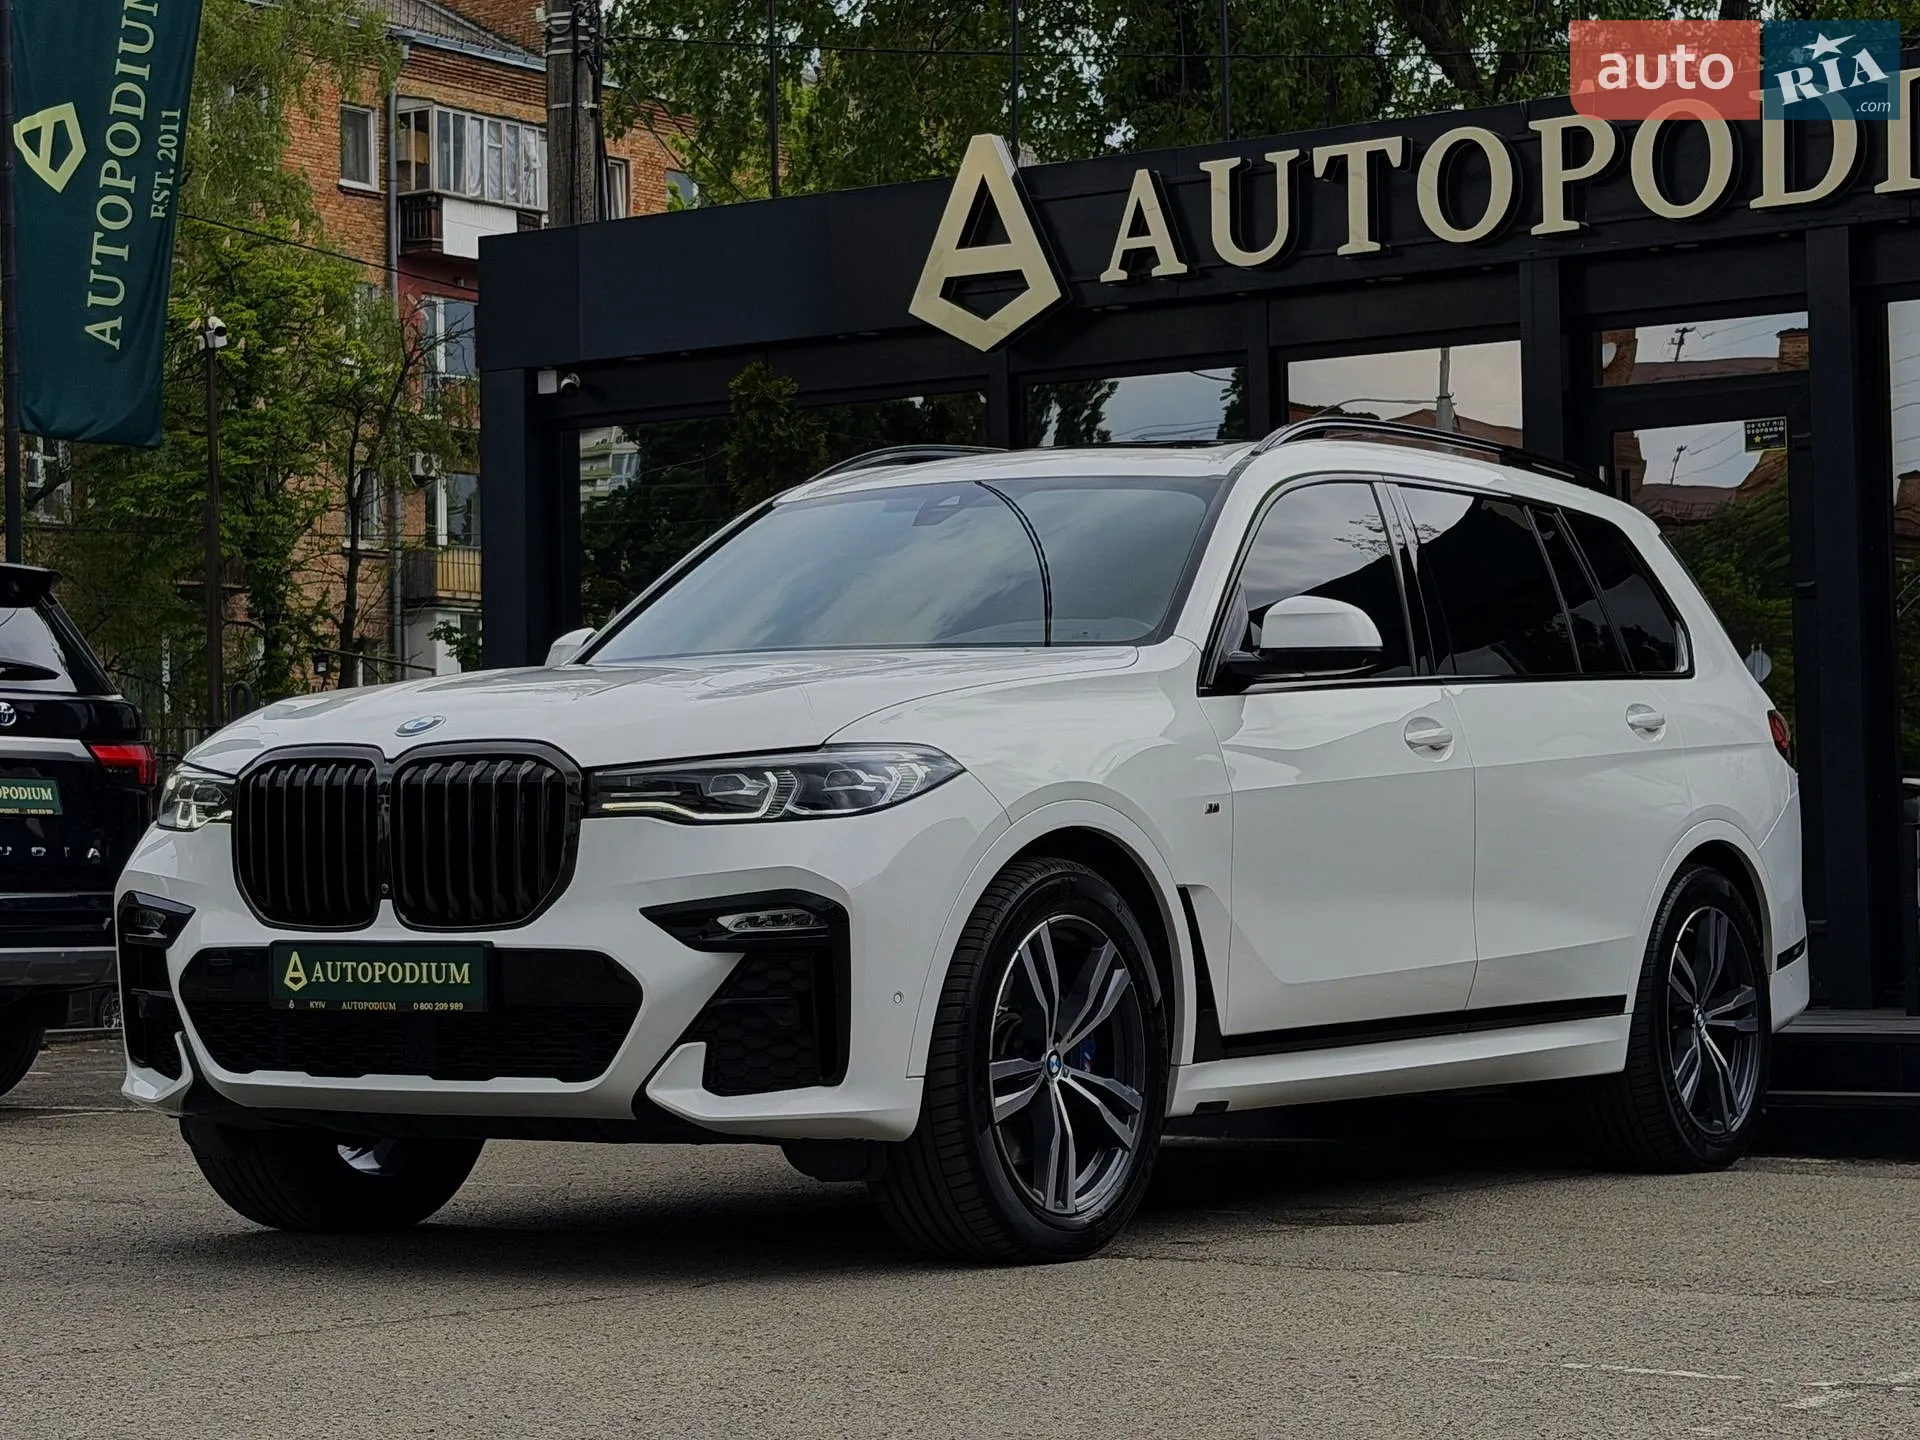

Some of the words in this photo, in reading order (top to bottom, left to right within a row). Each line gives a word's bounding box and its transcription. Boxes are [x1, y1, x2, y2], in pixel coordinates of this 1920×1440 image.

[157, 108, 181, 164] 2011
[150, 167, 175, 219] EST.
[0, 786, 53, 801] PODIUM
[311, 961, 471, 984] AUTOPODIUM
[309, 1001, 326, 1009] KYIV
[342, 1001, 396, 1010] AUTOPODIUM
